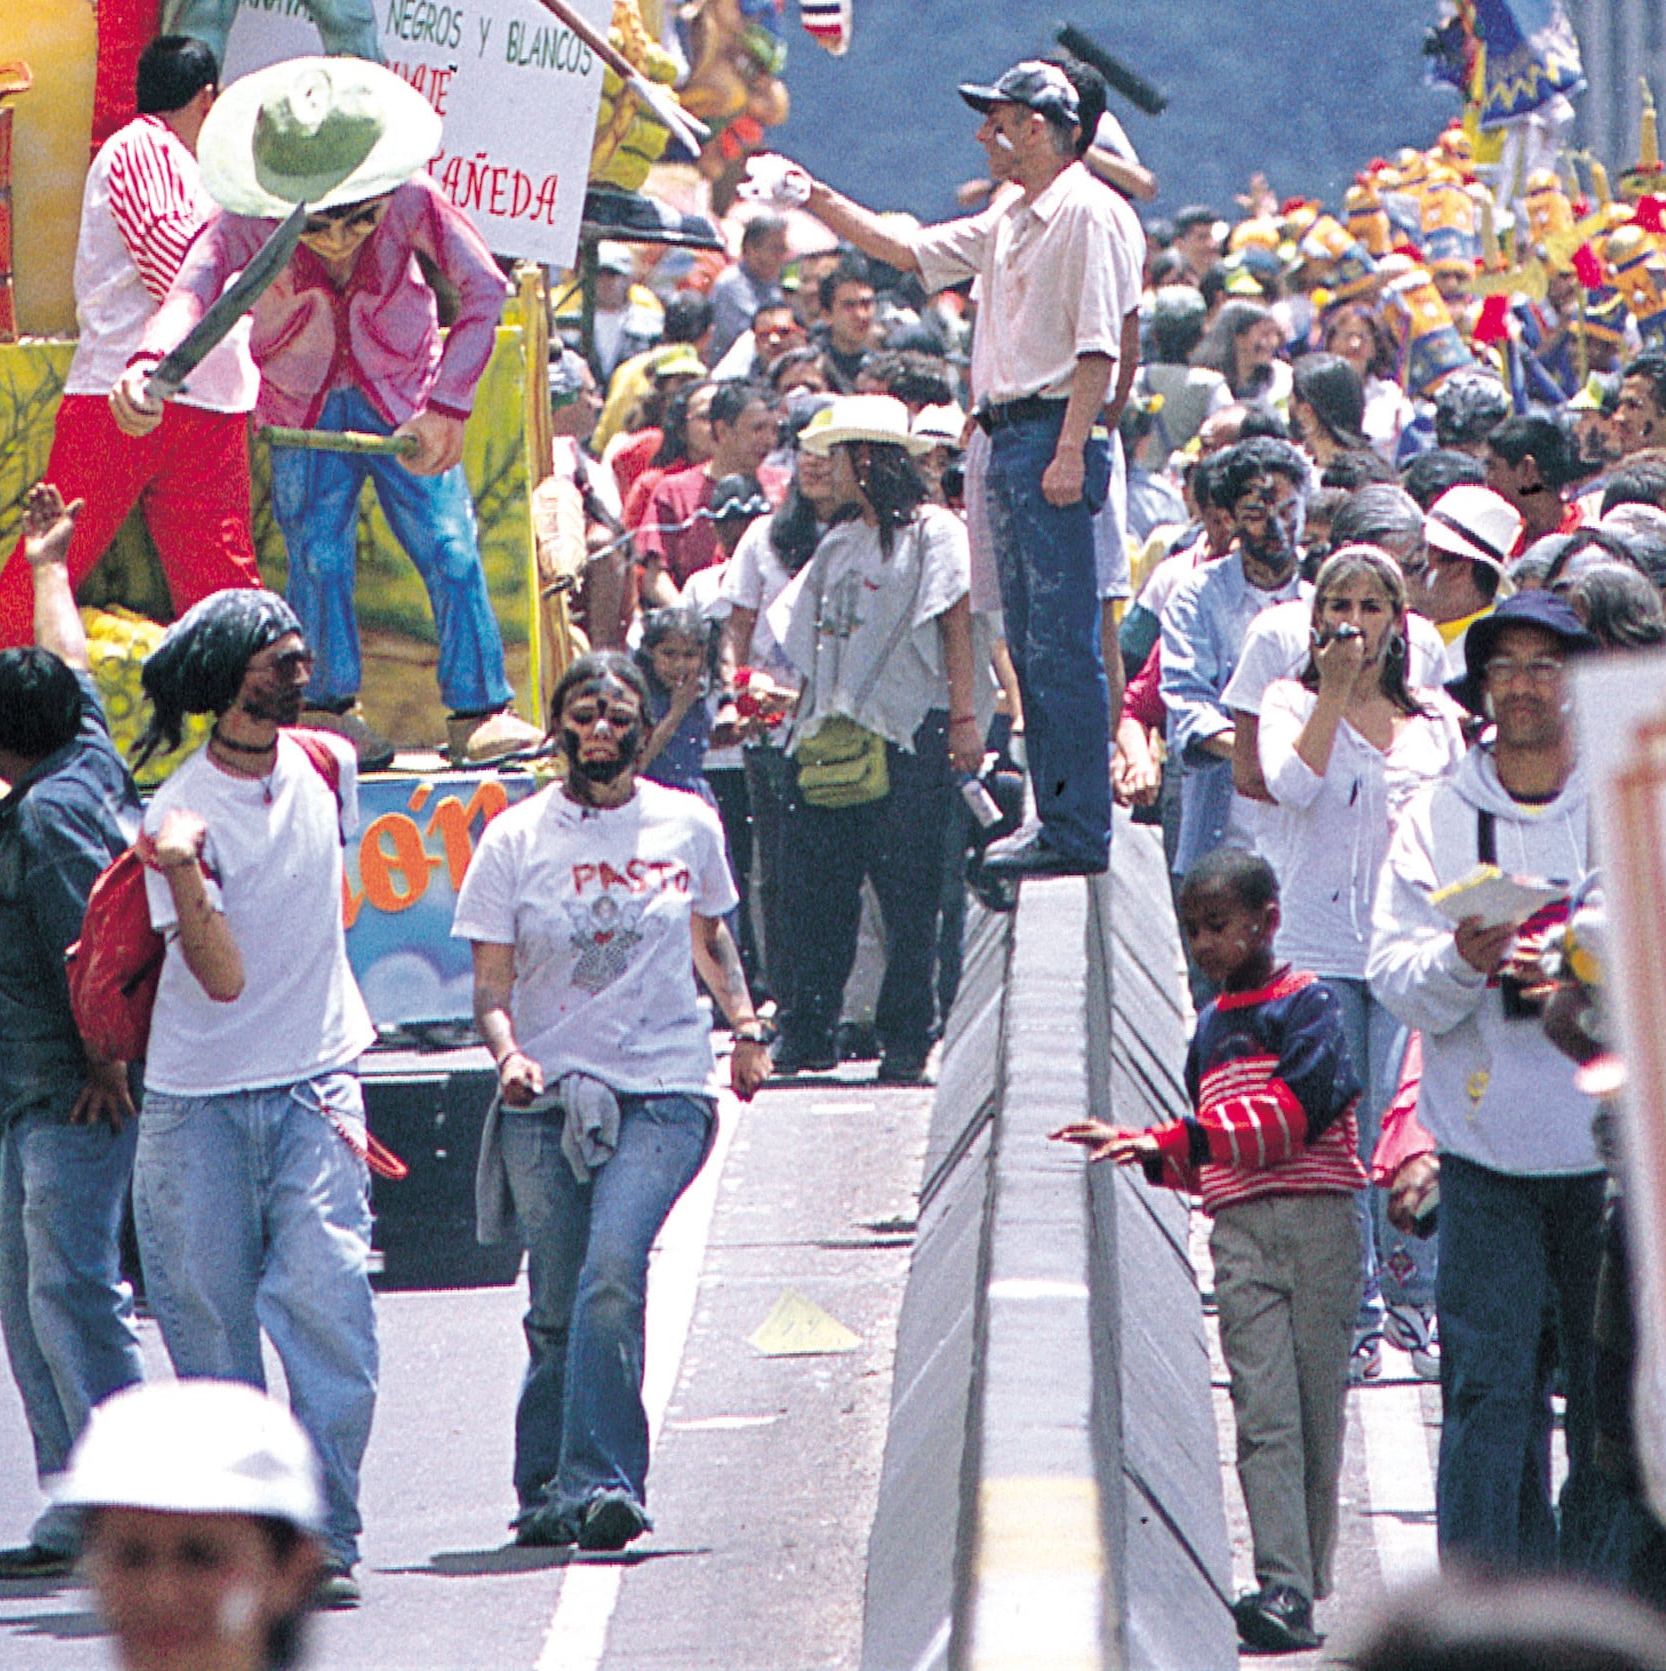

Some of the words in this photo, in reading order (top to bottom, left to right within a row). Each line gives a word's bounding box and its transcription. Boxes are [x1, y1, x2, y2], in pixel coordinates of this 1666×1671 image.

[477, 16, 492, 59] Y
[506, 19, 593, 77] BLANCOS
[572, 858, 690, 895] PASTO
